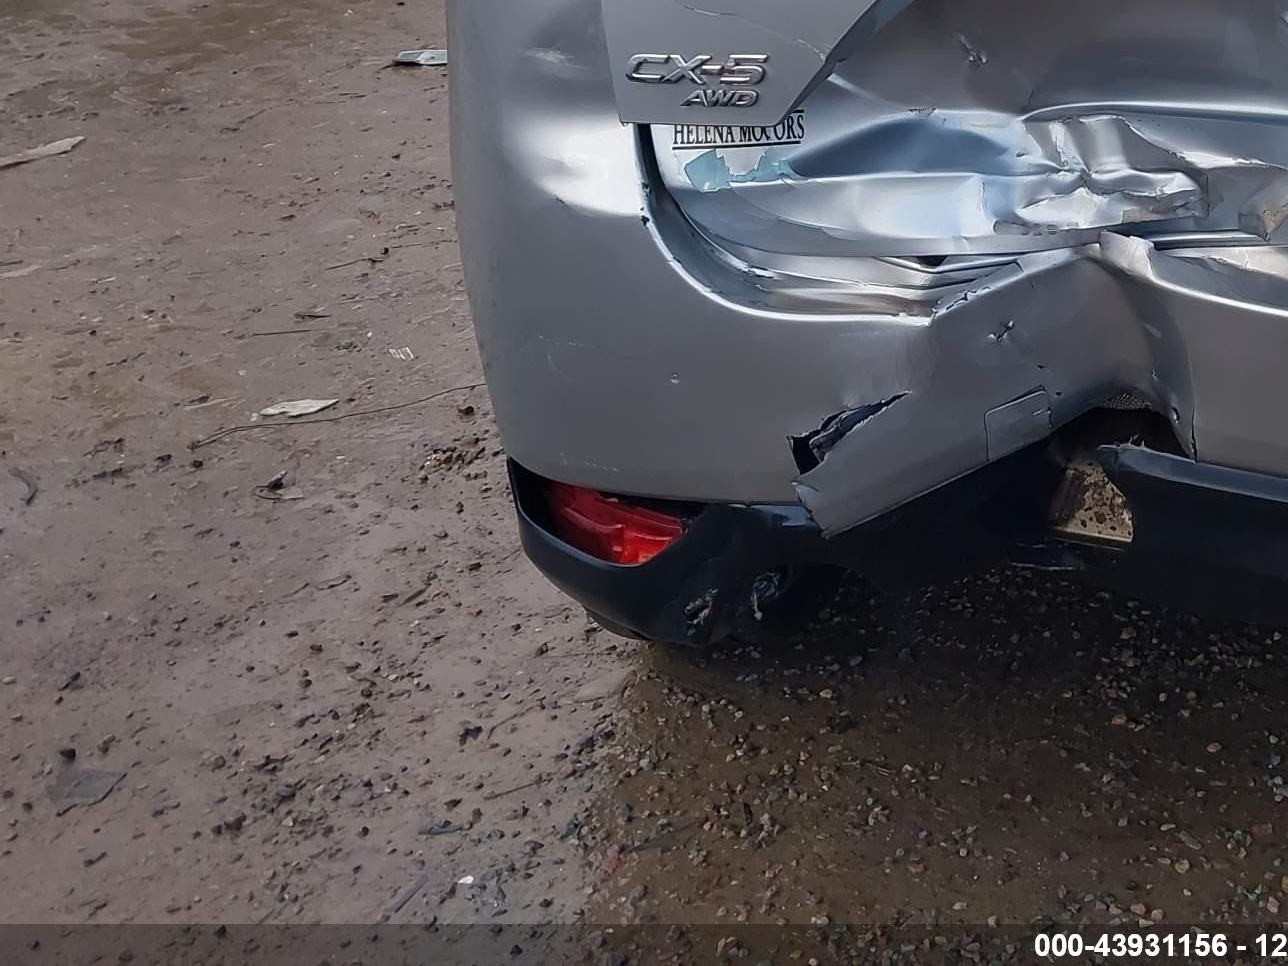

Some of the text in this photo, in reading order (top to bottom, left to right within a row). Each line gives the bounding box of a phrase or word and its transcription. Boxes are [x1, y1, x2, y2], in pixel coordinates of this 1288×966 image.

[626, 53, 769, 86] CX-5
[680, 89, 758, 107] AWD
[673, 124, 735, 145] HELENA
